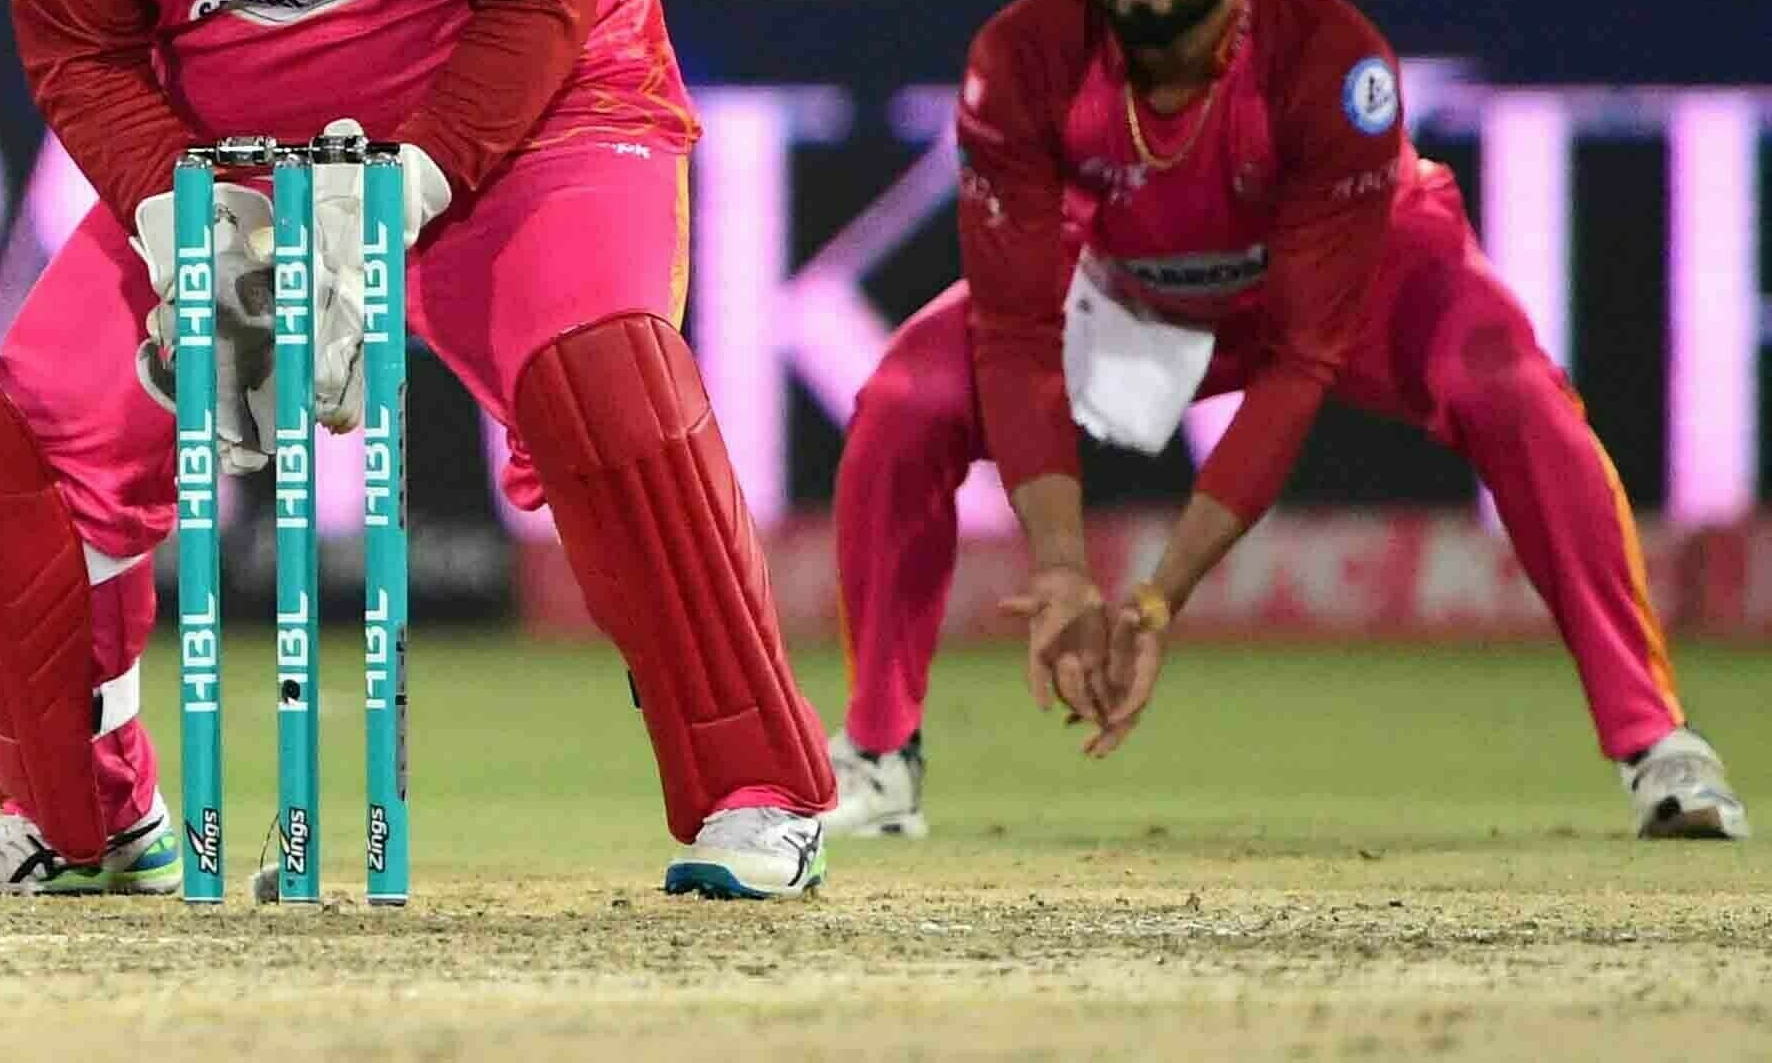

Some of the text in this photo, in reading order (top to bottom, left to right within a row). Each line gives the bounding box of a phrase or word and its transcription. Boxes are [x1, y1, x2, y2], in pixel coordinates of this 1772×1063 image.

[179, 224, 213, 346] HBL
[275, 224, 309, 345] HBL
[364, 223, 389, 343] HBL
[179, 409, 214, 529] HBL
[276, 407, 309, 529] HBL
[364, 405, 391, 526] HBL
[182, 592, 218, 712] HBL
[277, 591, 309, 712] HBL
[365, 588, 388, 709] HBL
